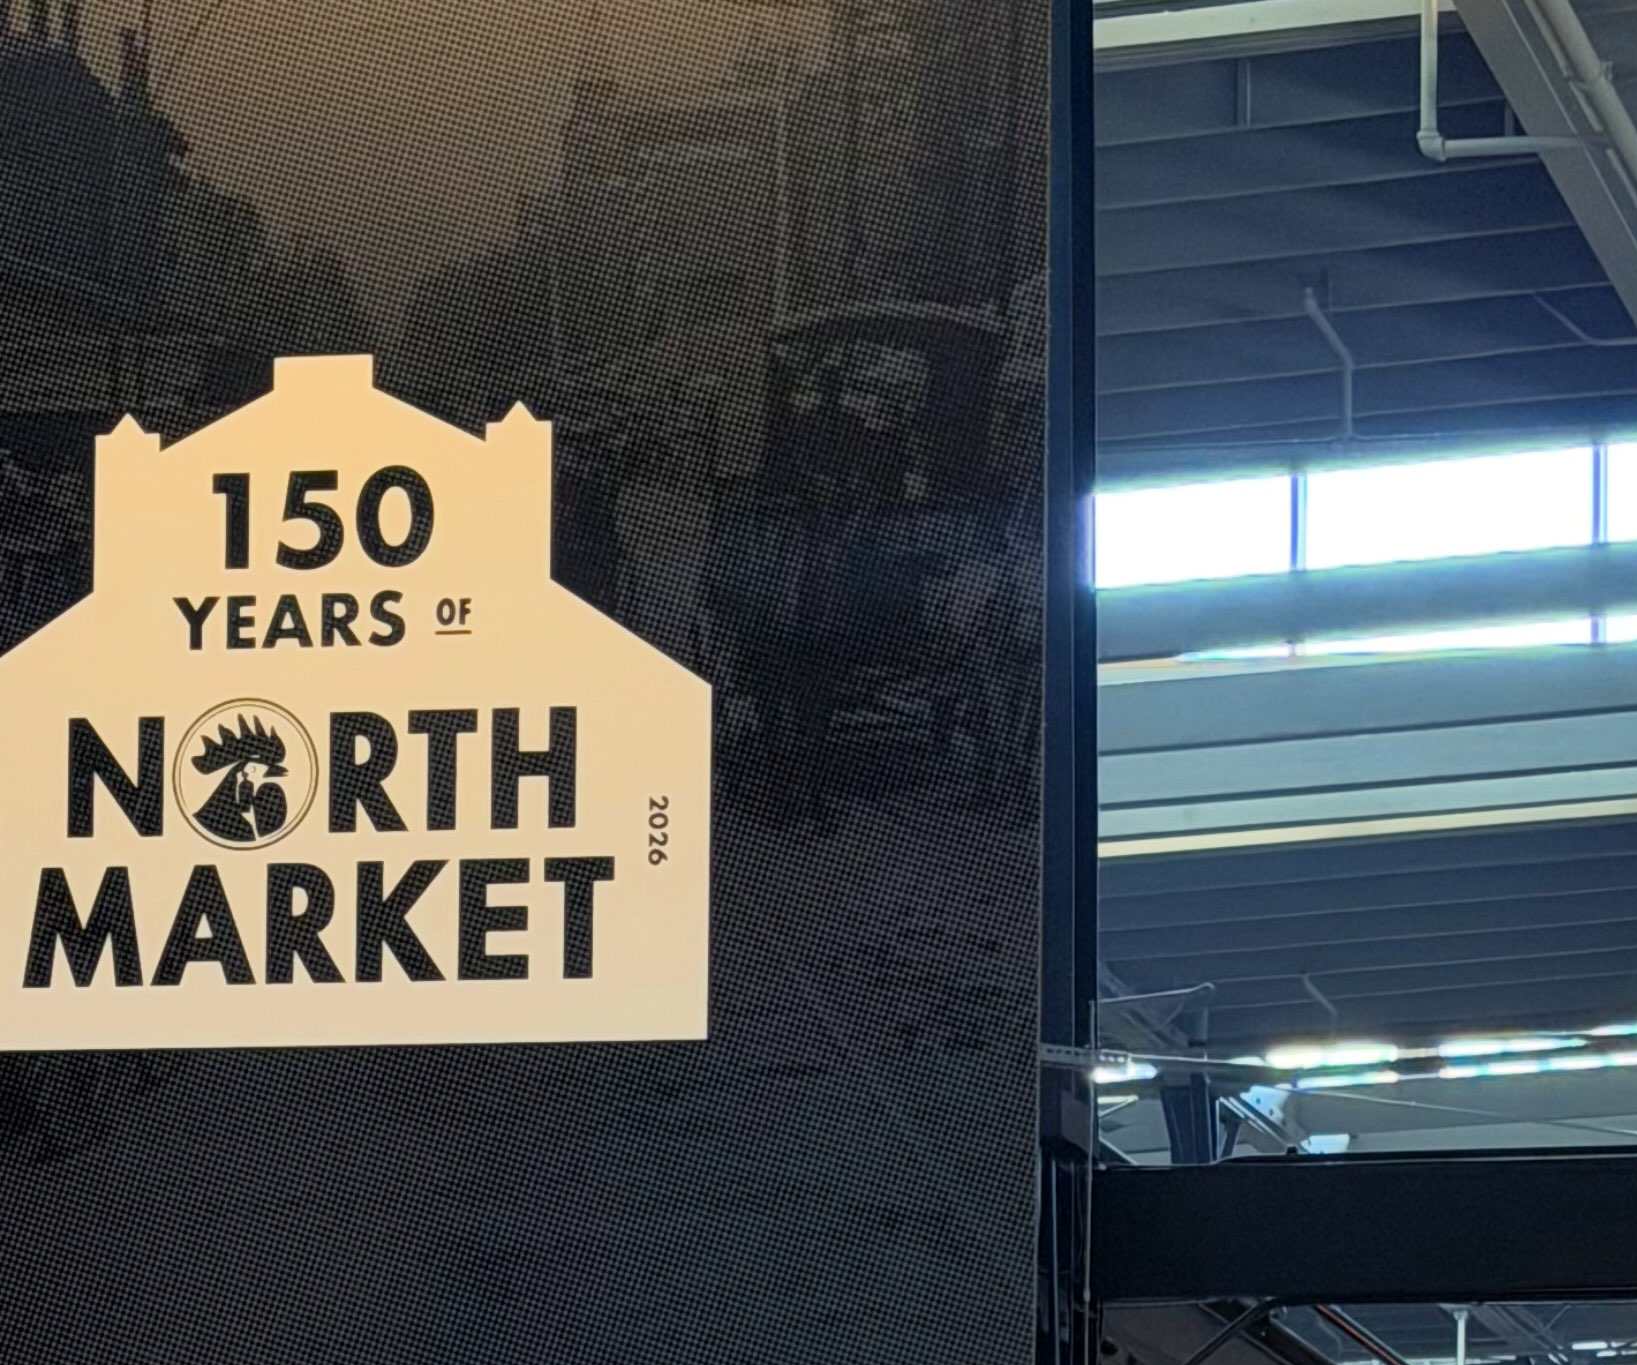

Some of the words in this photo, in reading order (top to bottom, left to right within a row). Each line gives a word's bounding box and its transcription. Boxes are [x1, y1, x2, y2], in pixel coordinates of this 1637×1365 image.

[211, 465, 435, 571] 150
[173, 589, 407, 651] YEARS
[435, 597, 472, 628] OF
[646, 795, 669, 867] 2026
[22, 855, 616, 989] MARKET
